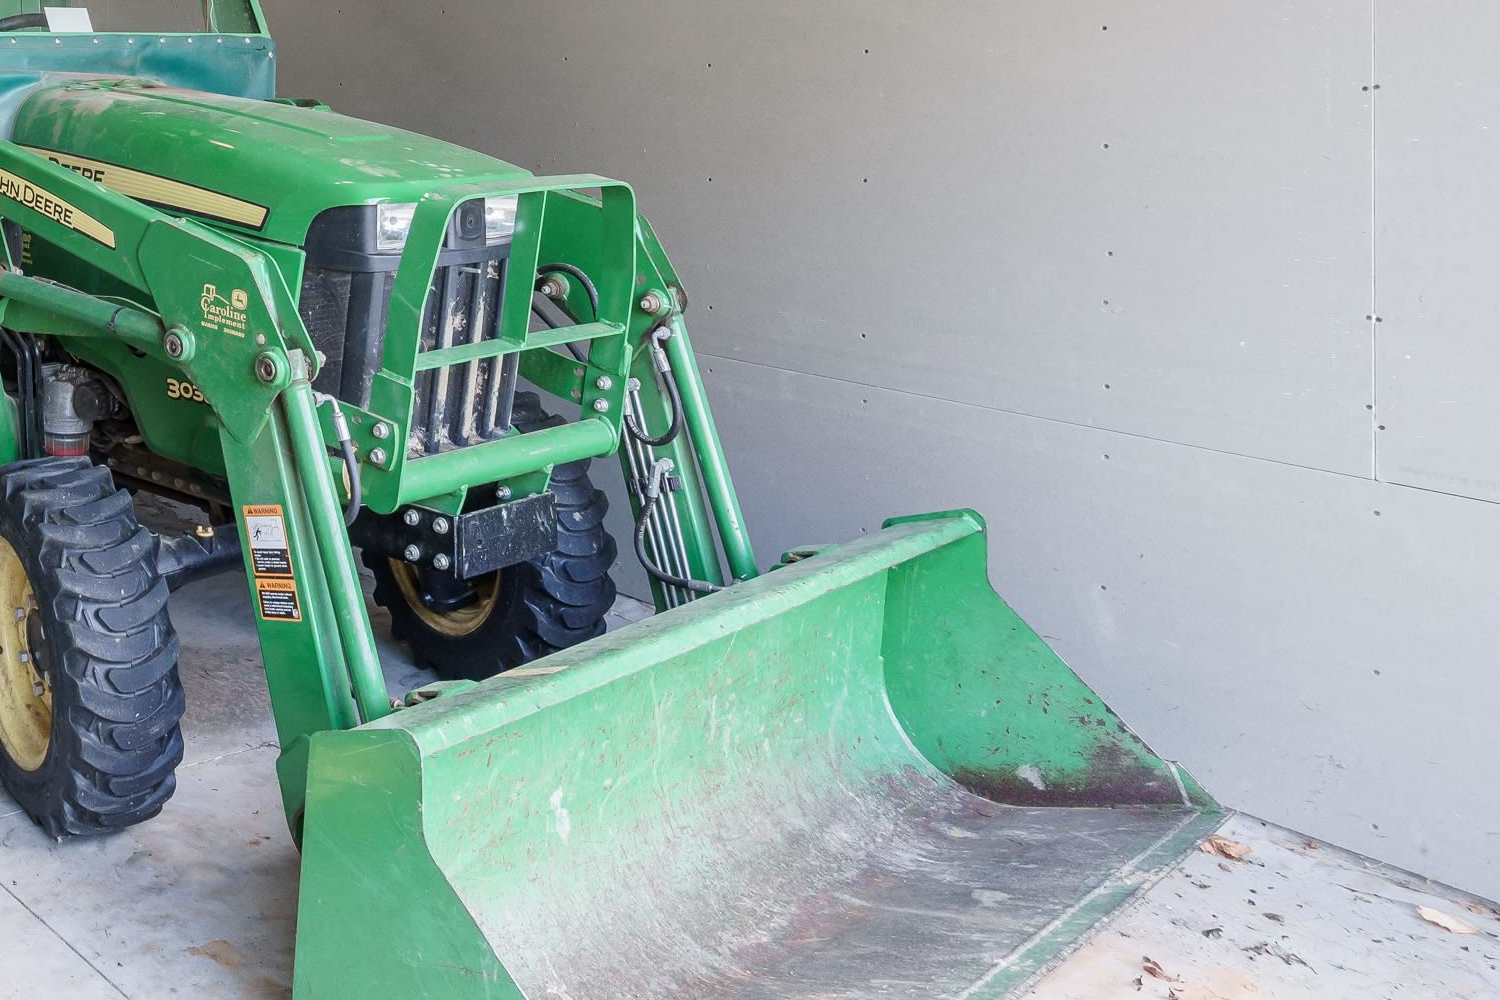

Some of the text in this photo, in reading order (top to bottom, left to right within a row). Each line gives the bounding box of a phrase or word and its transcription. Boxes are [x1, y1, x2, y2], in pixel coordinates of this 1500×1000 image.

[23, 184, 74, 226] DEERE
[201, 296, 247, 322] Caroline
[166, 377, 211, 405] 303
[253, 507, 278, 515] WARNING
[266, 582, 292, 590] WARNING
